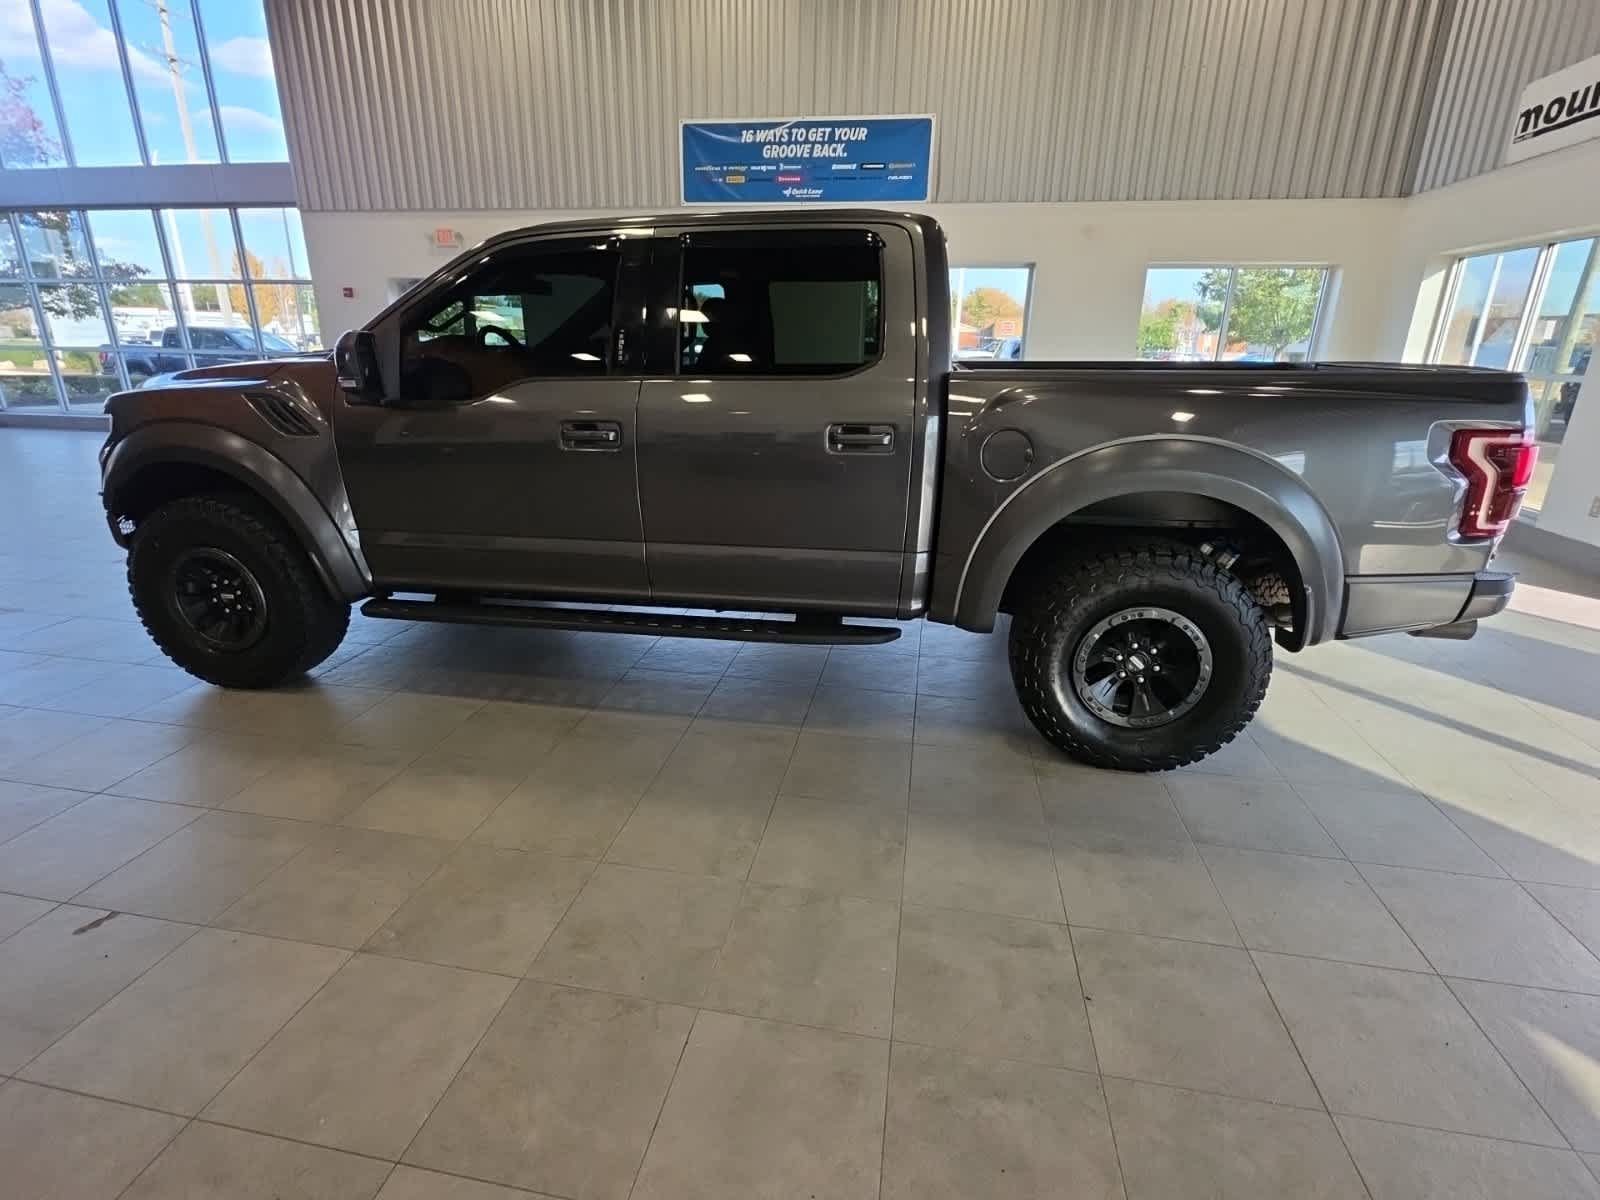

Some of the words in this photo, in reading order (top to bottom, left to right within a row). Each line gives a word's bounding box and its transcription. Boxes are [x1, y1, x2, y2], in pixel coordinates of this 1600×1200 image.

[741, 129, 754, 143] 16
[755, 128, 789, 143] WAYS
[791, 127, 807, 142] TO
[808, 127, 832, 141] GET
[834, 127, 868, 141] YOUR
[763, 144, 811, 158] GROOVE
[812, 143, 848, 158] BACK.
